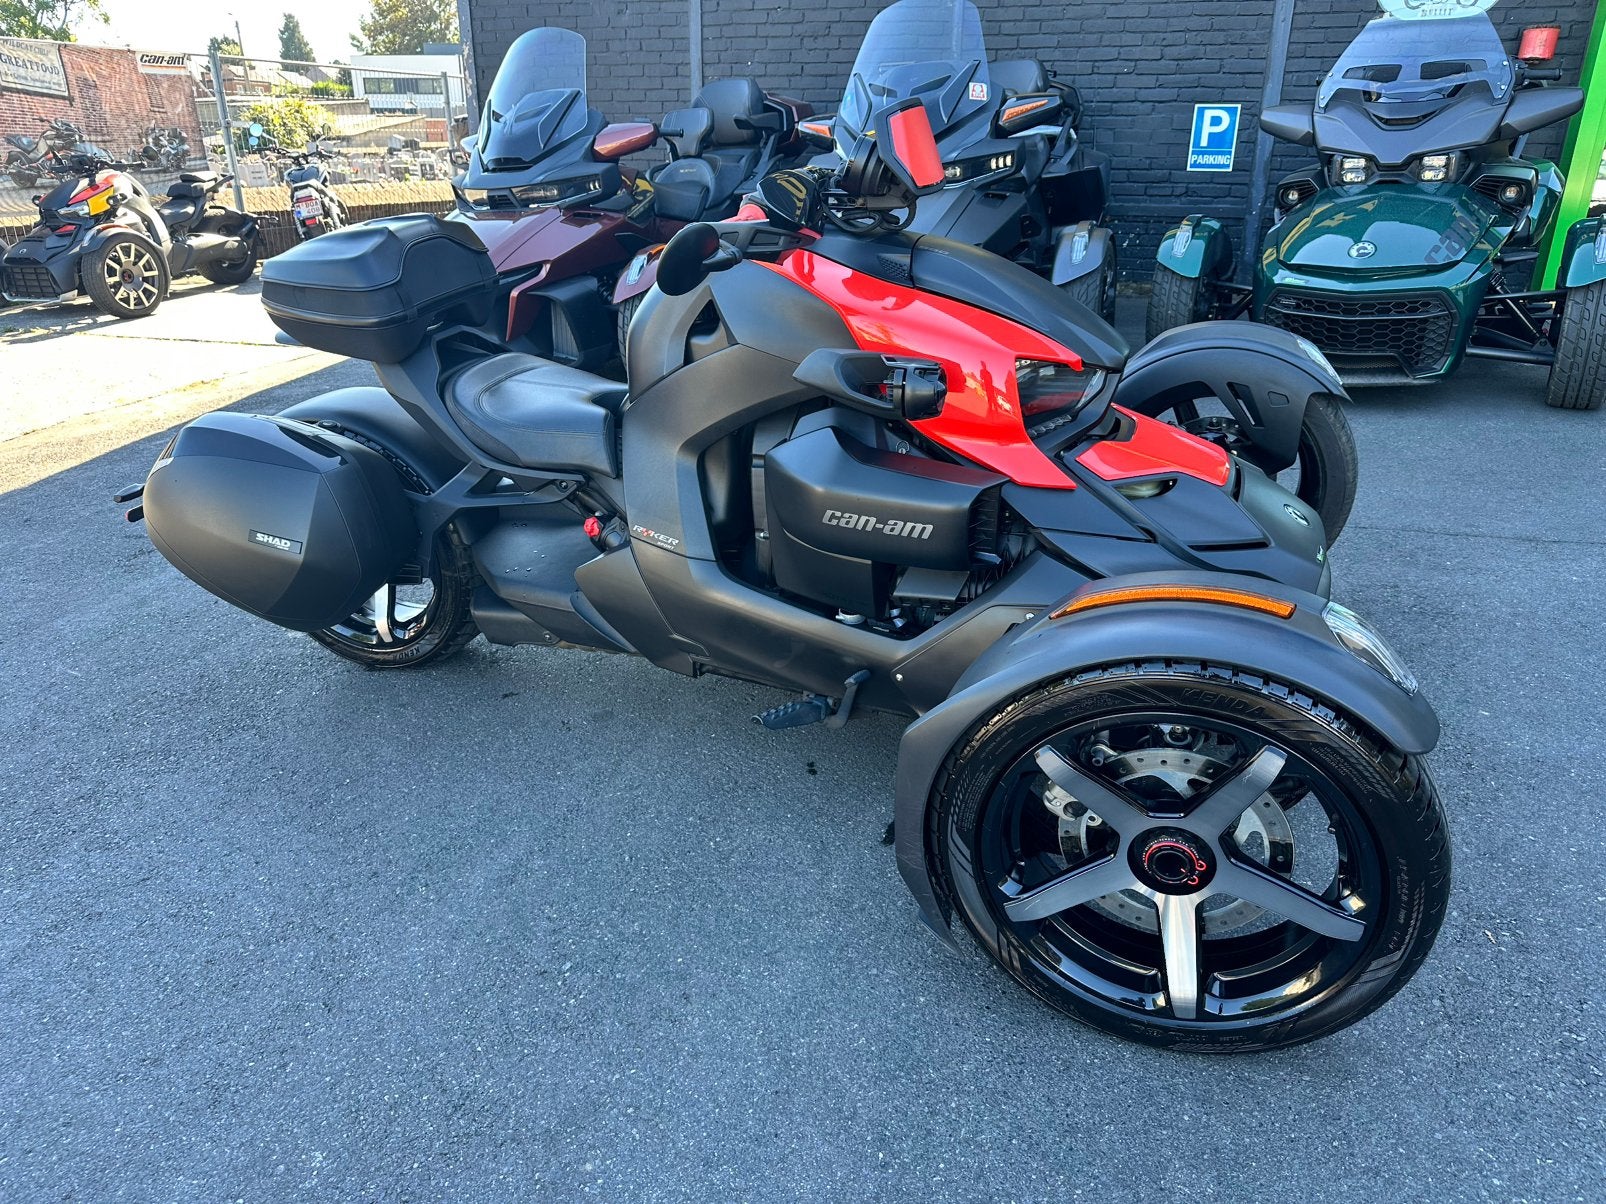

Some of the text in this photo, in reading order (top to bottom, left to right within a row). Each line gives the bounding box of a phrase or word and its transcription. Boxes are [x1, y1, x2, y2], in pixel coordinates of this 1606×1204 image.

[140, 54, 185, 65] can-am
[1200, 109, 1230, 147] P
[1191, 154, 1231, 165] PARKING
[822, 509, 934, 540] can-am
[255, 533, 291, 548] SHAD
[1179, 687, 1267, 718] KENDA
